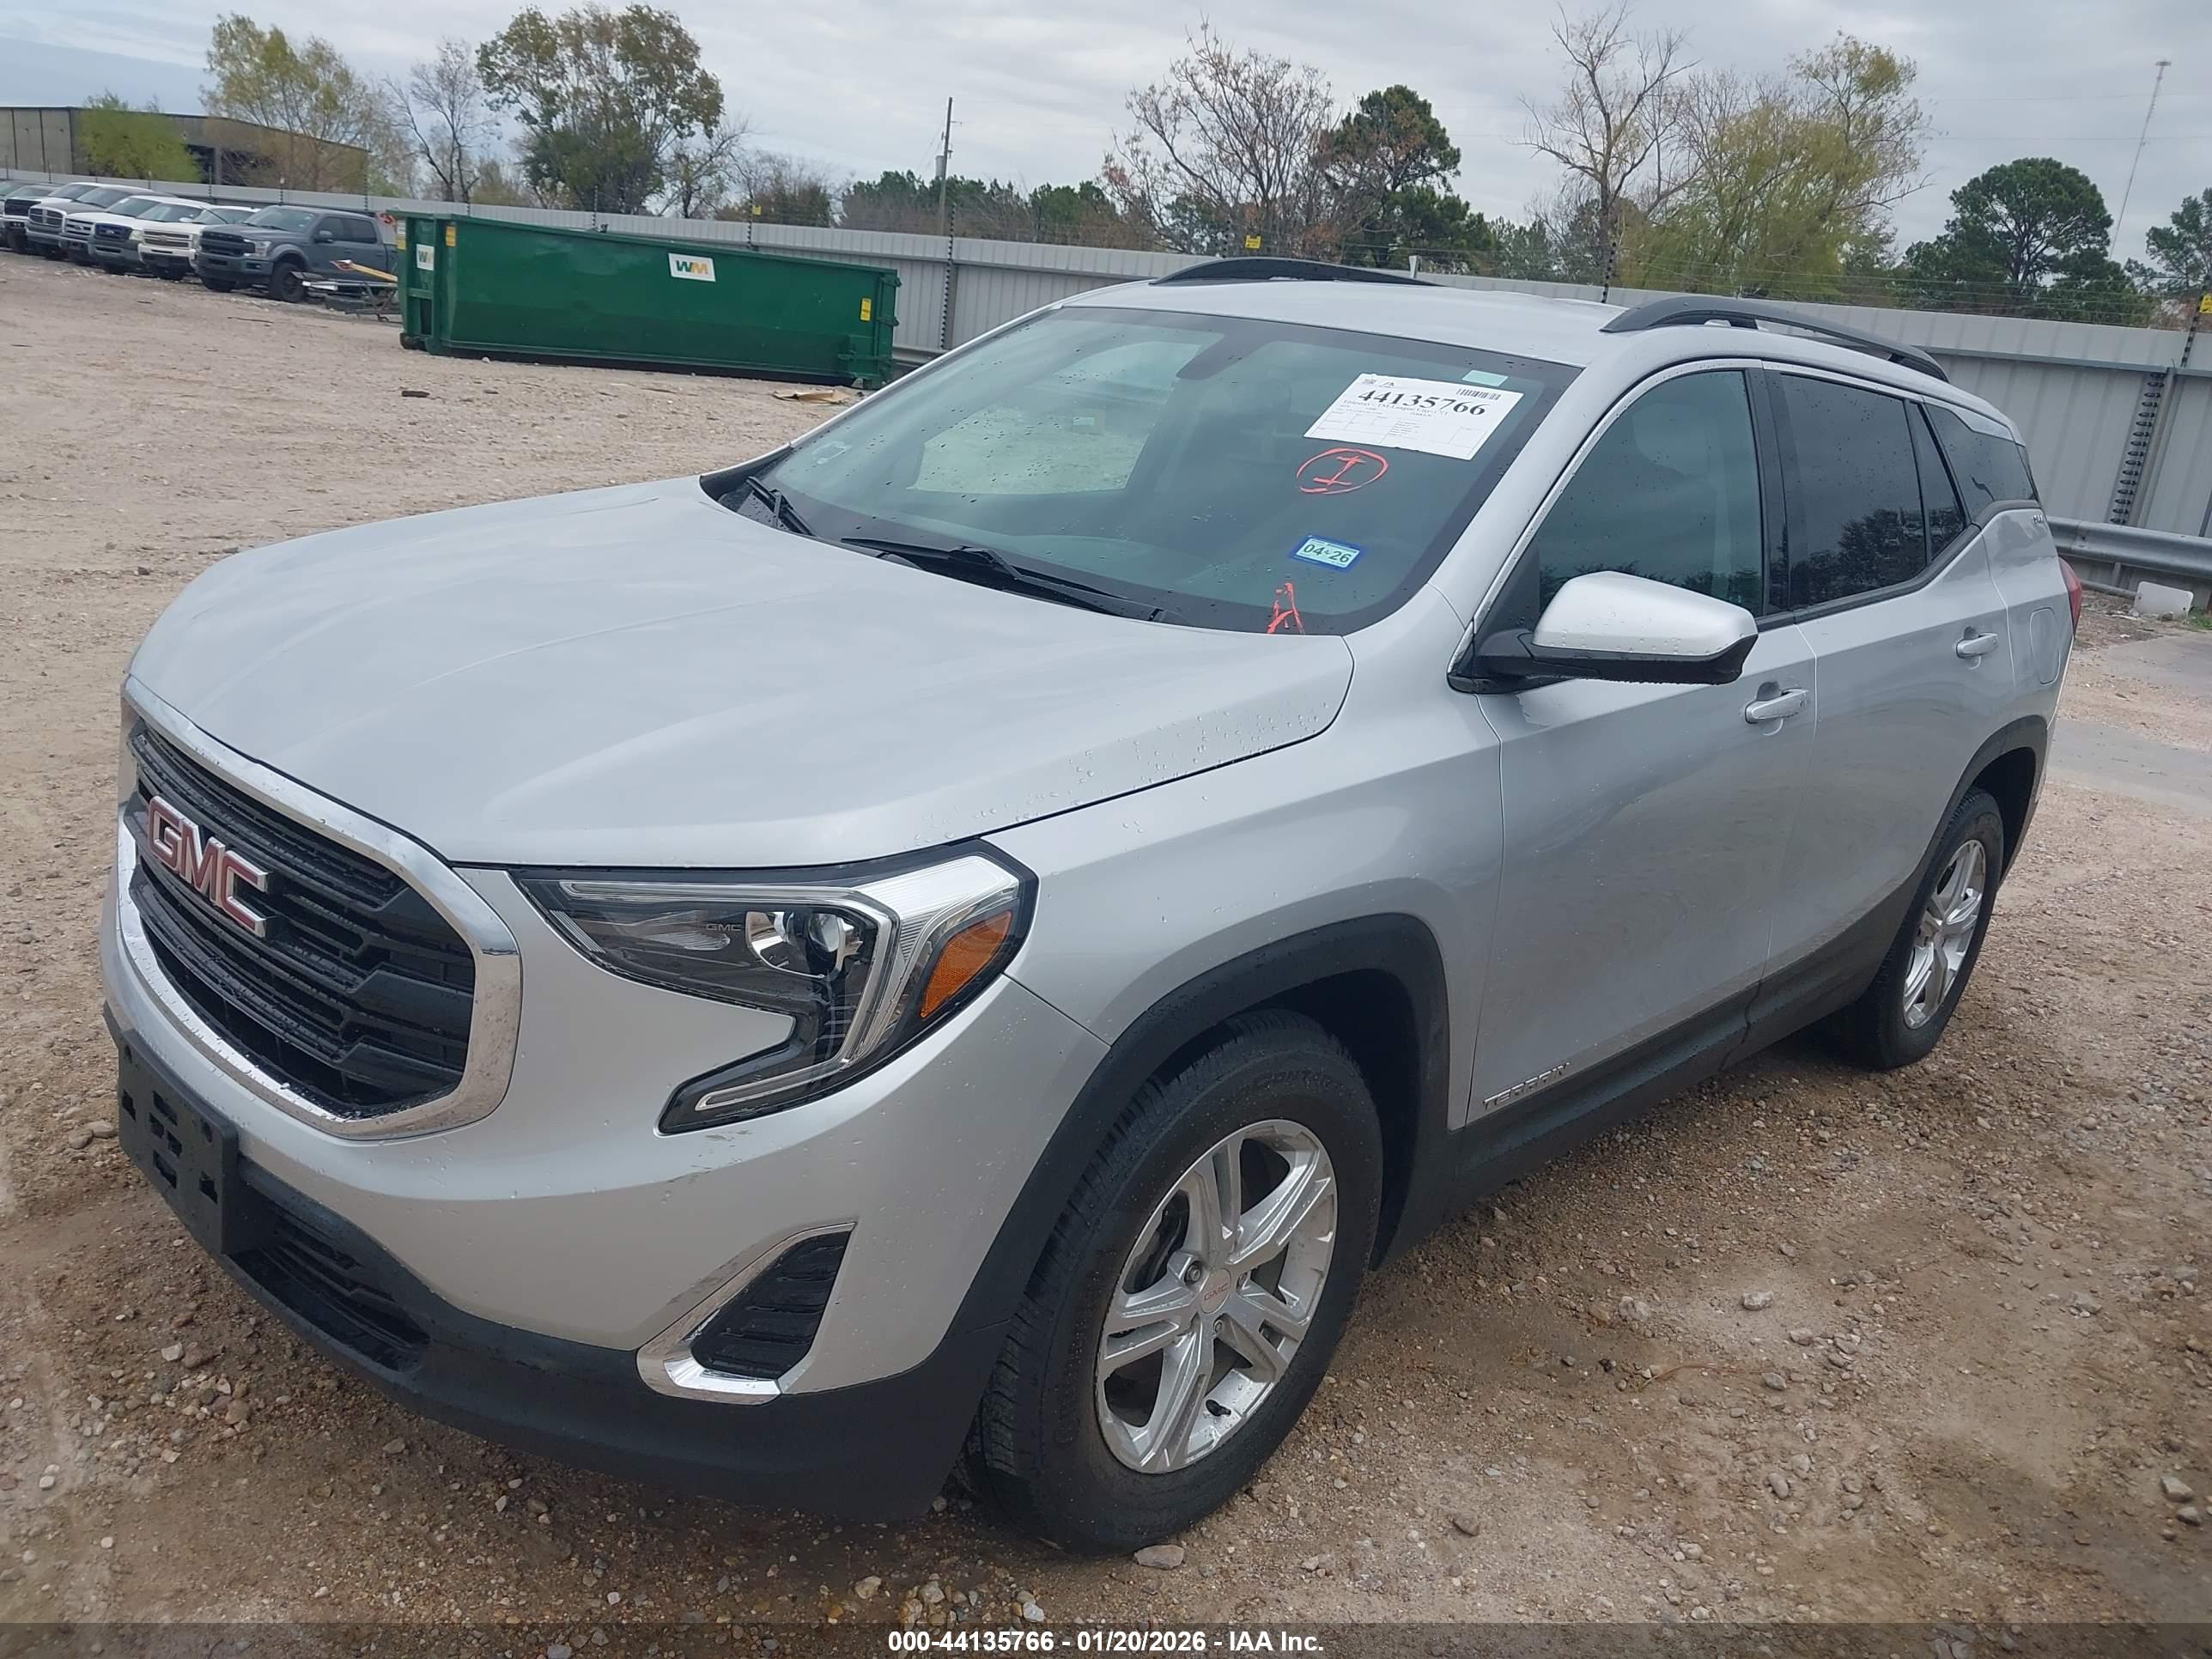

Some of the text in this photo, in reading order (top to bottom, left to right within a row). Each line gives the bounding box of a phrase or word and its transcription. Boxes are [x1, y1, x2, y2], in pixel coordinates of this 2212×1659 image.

[675, 259, 709, 275] WM
[1357, 389, 1491, 416] 44135766
[149, 795, 270, 939] GMC
[706, 923, 742, 932] GMC
[1204, 1283, 1229, 1301] GMC
